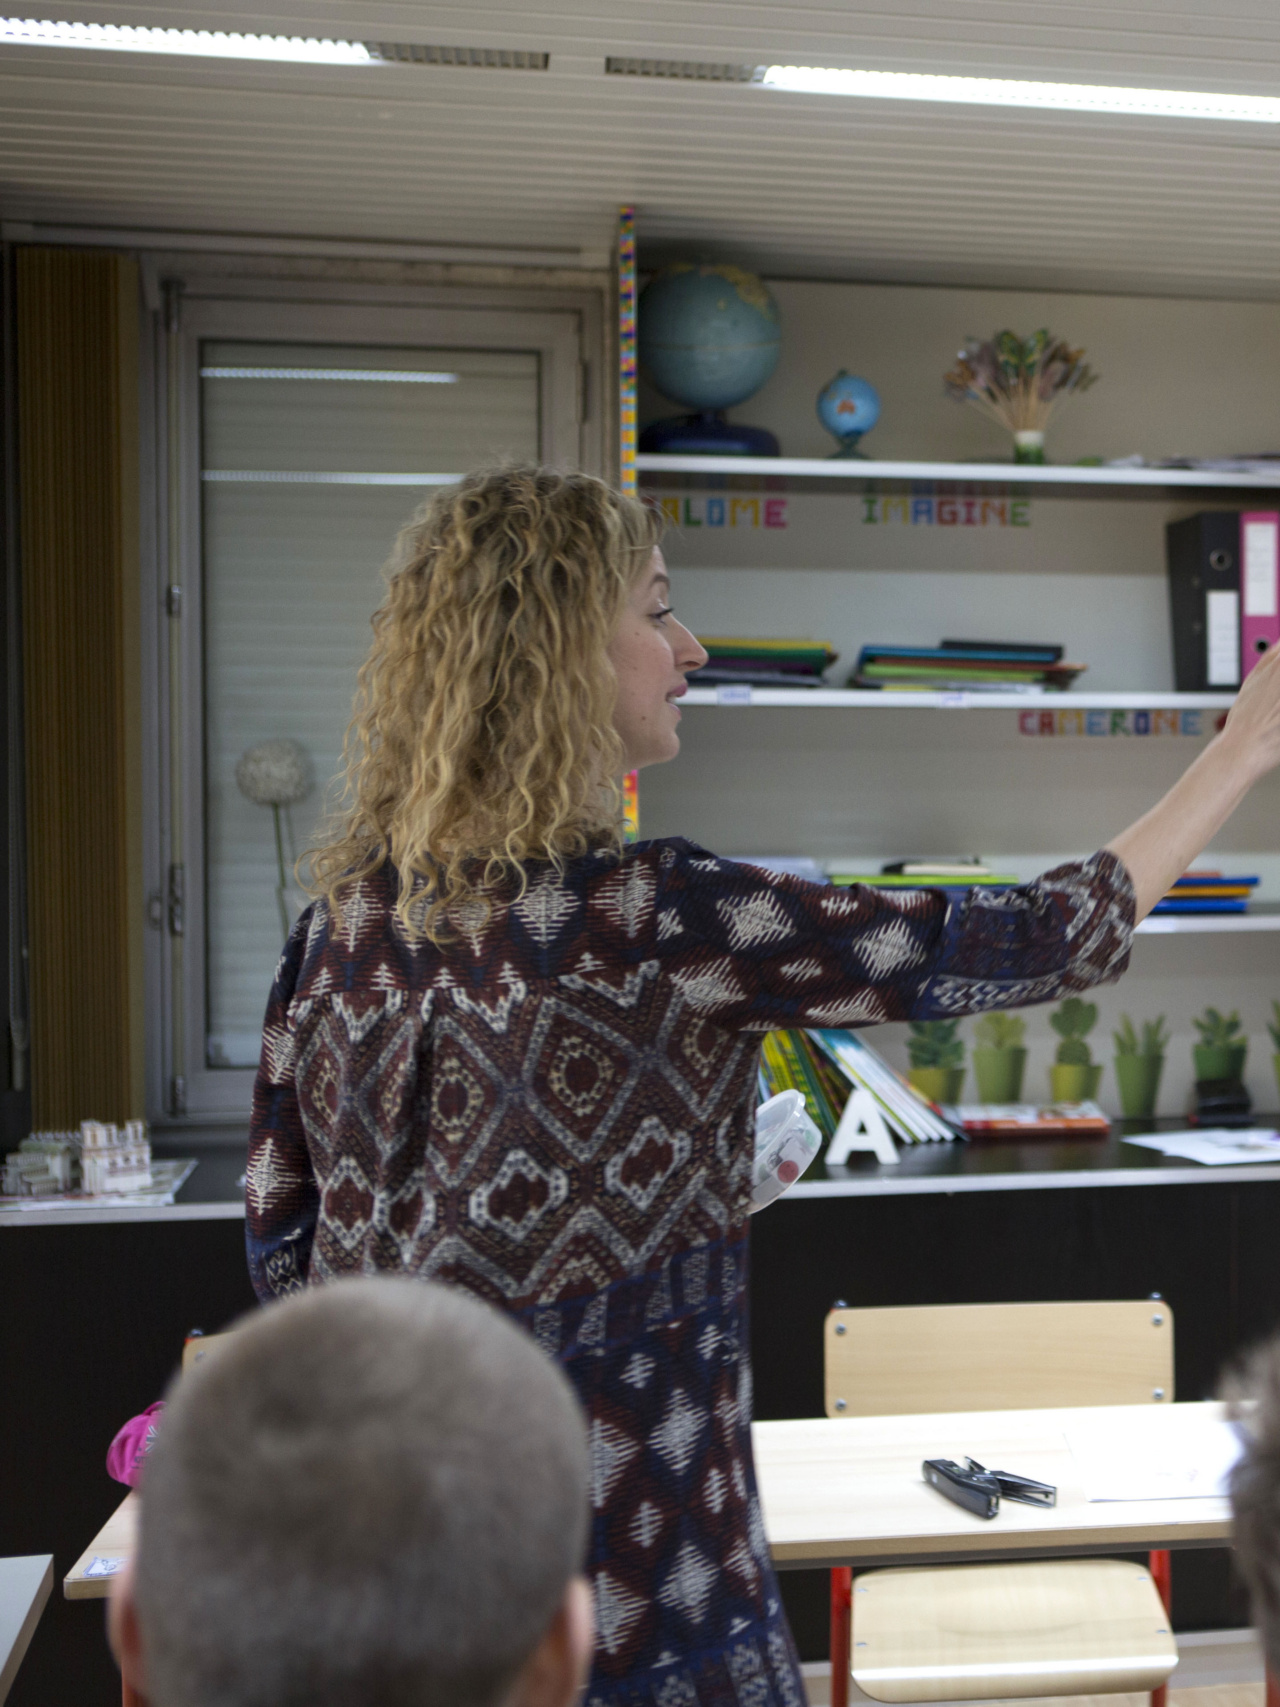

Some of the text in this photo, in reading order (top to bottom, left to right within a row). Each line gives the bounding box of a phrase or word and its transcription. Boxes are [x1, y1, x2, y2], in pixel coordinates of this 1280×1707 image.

[863, 498, 1031, 528] IMAGINE
[1019, 709, 1202, 735] CAMERONE
[826, 1088, 901, 1165] A
